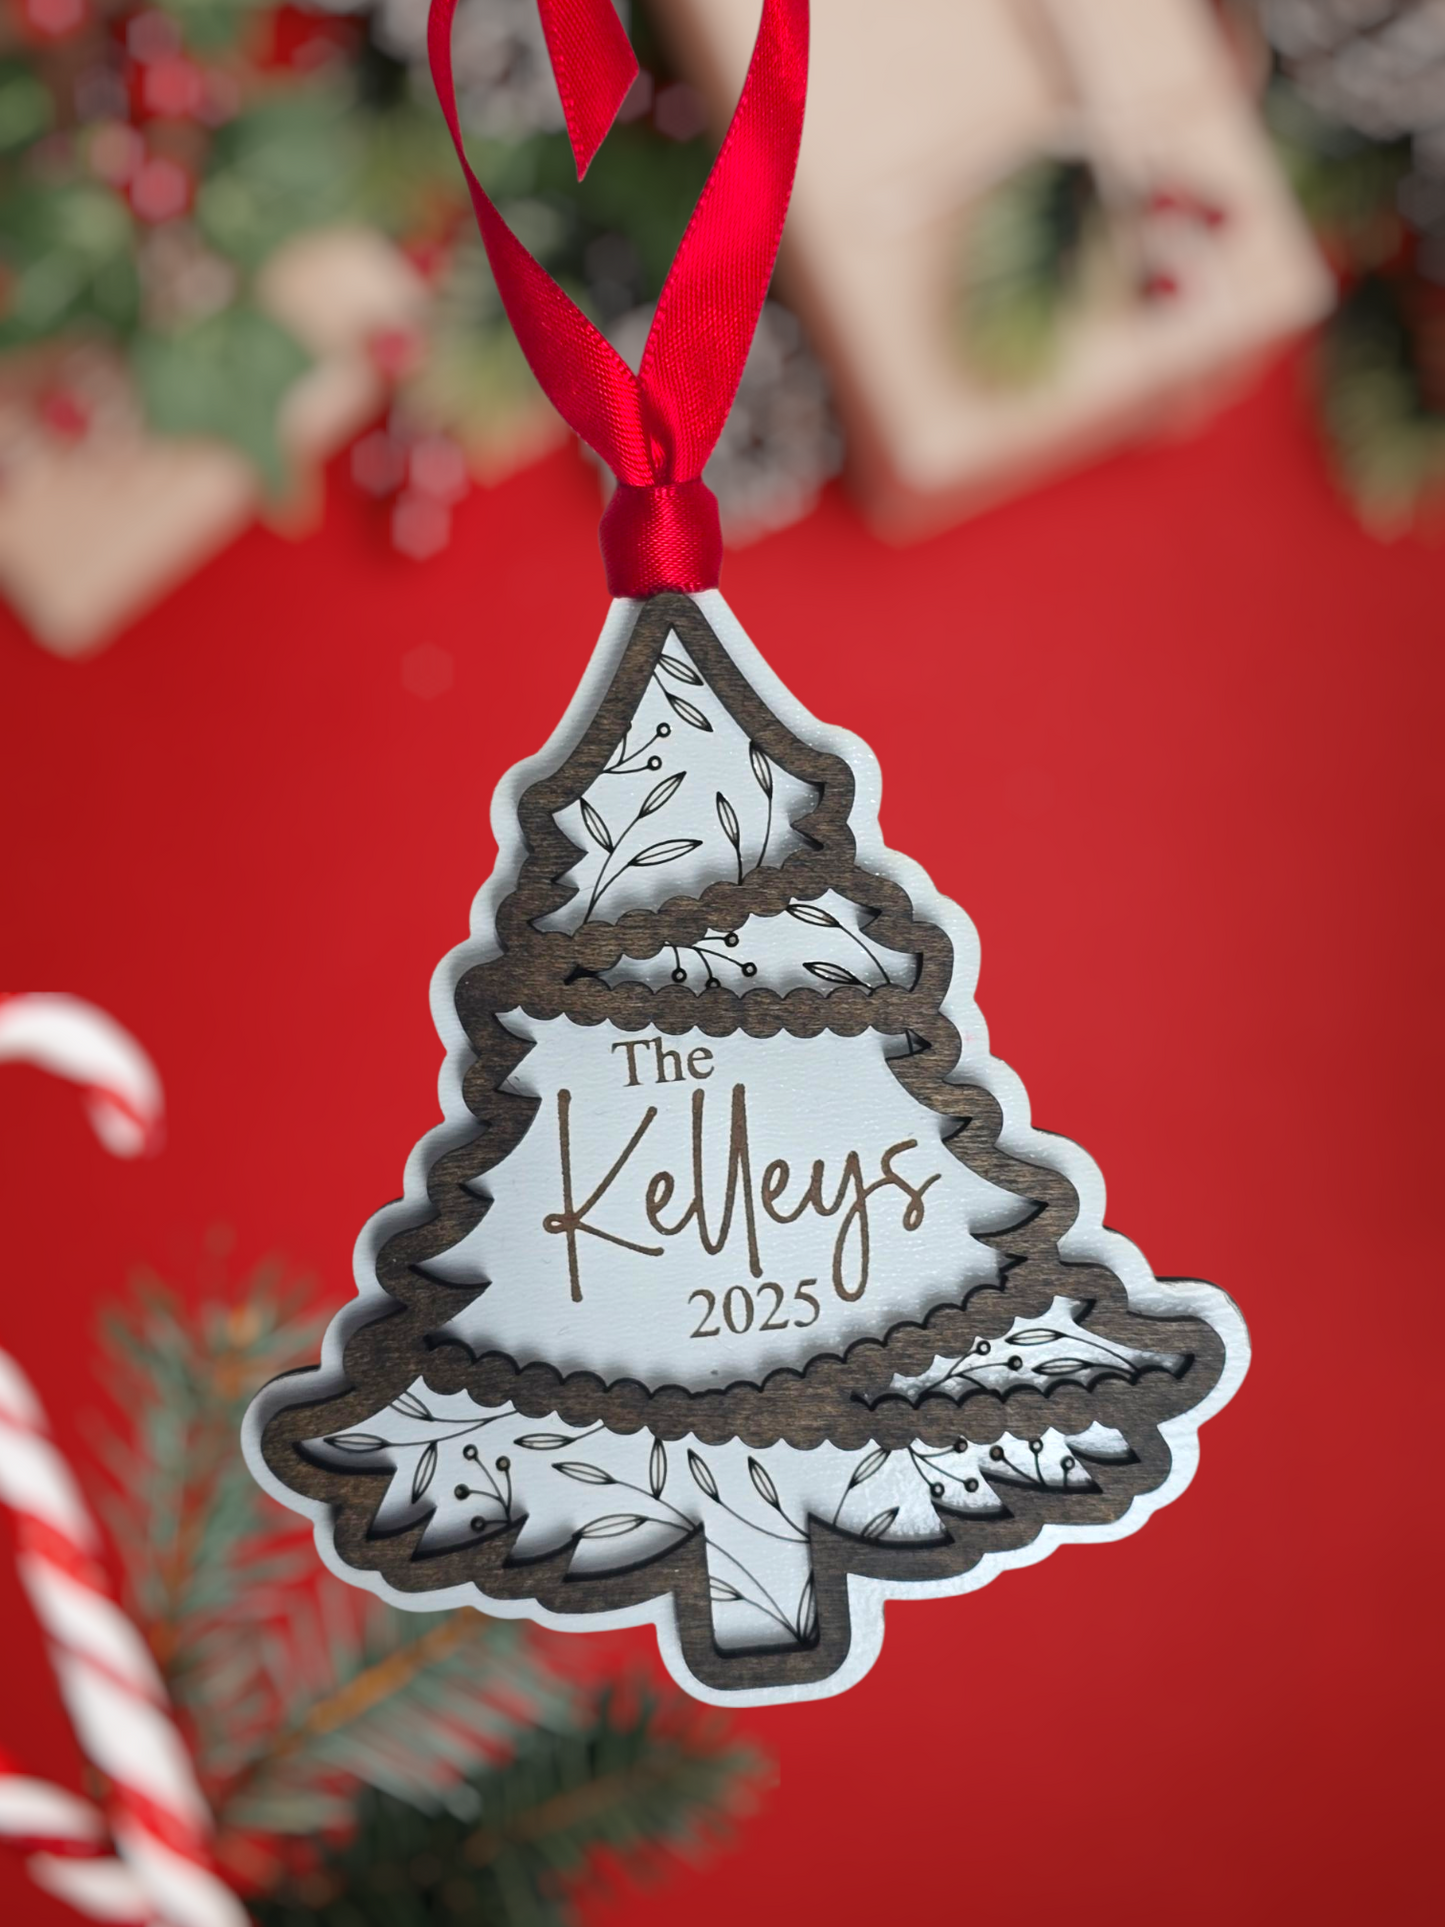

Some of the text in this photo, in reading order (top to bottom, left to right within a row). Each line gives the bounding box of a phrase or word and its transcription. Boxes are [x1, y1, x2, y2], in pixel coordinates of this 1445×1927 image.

[611, 1036, 715, 1087] The
[542, 1083, 942, 1303] Kelleys
[687, 1278, 821, 1339] 2025
